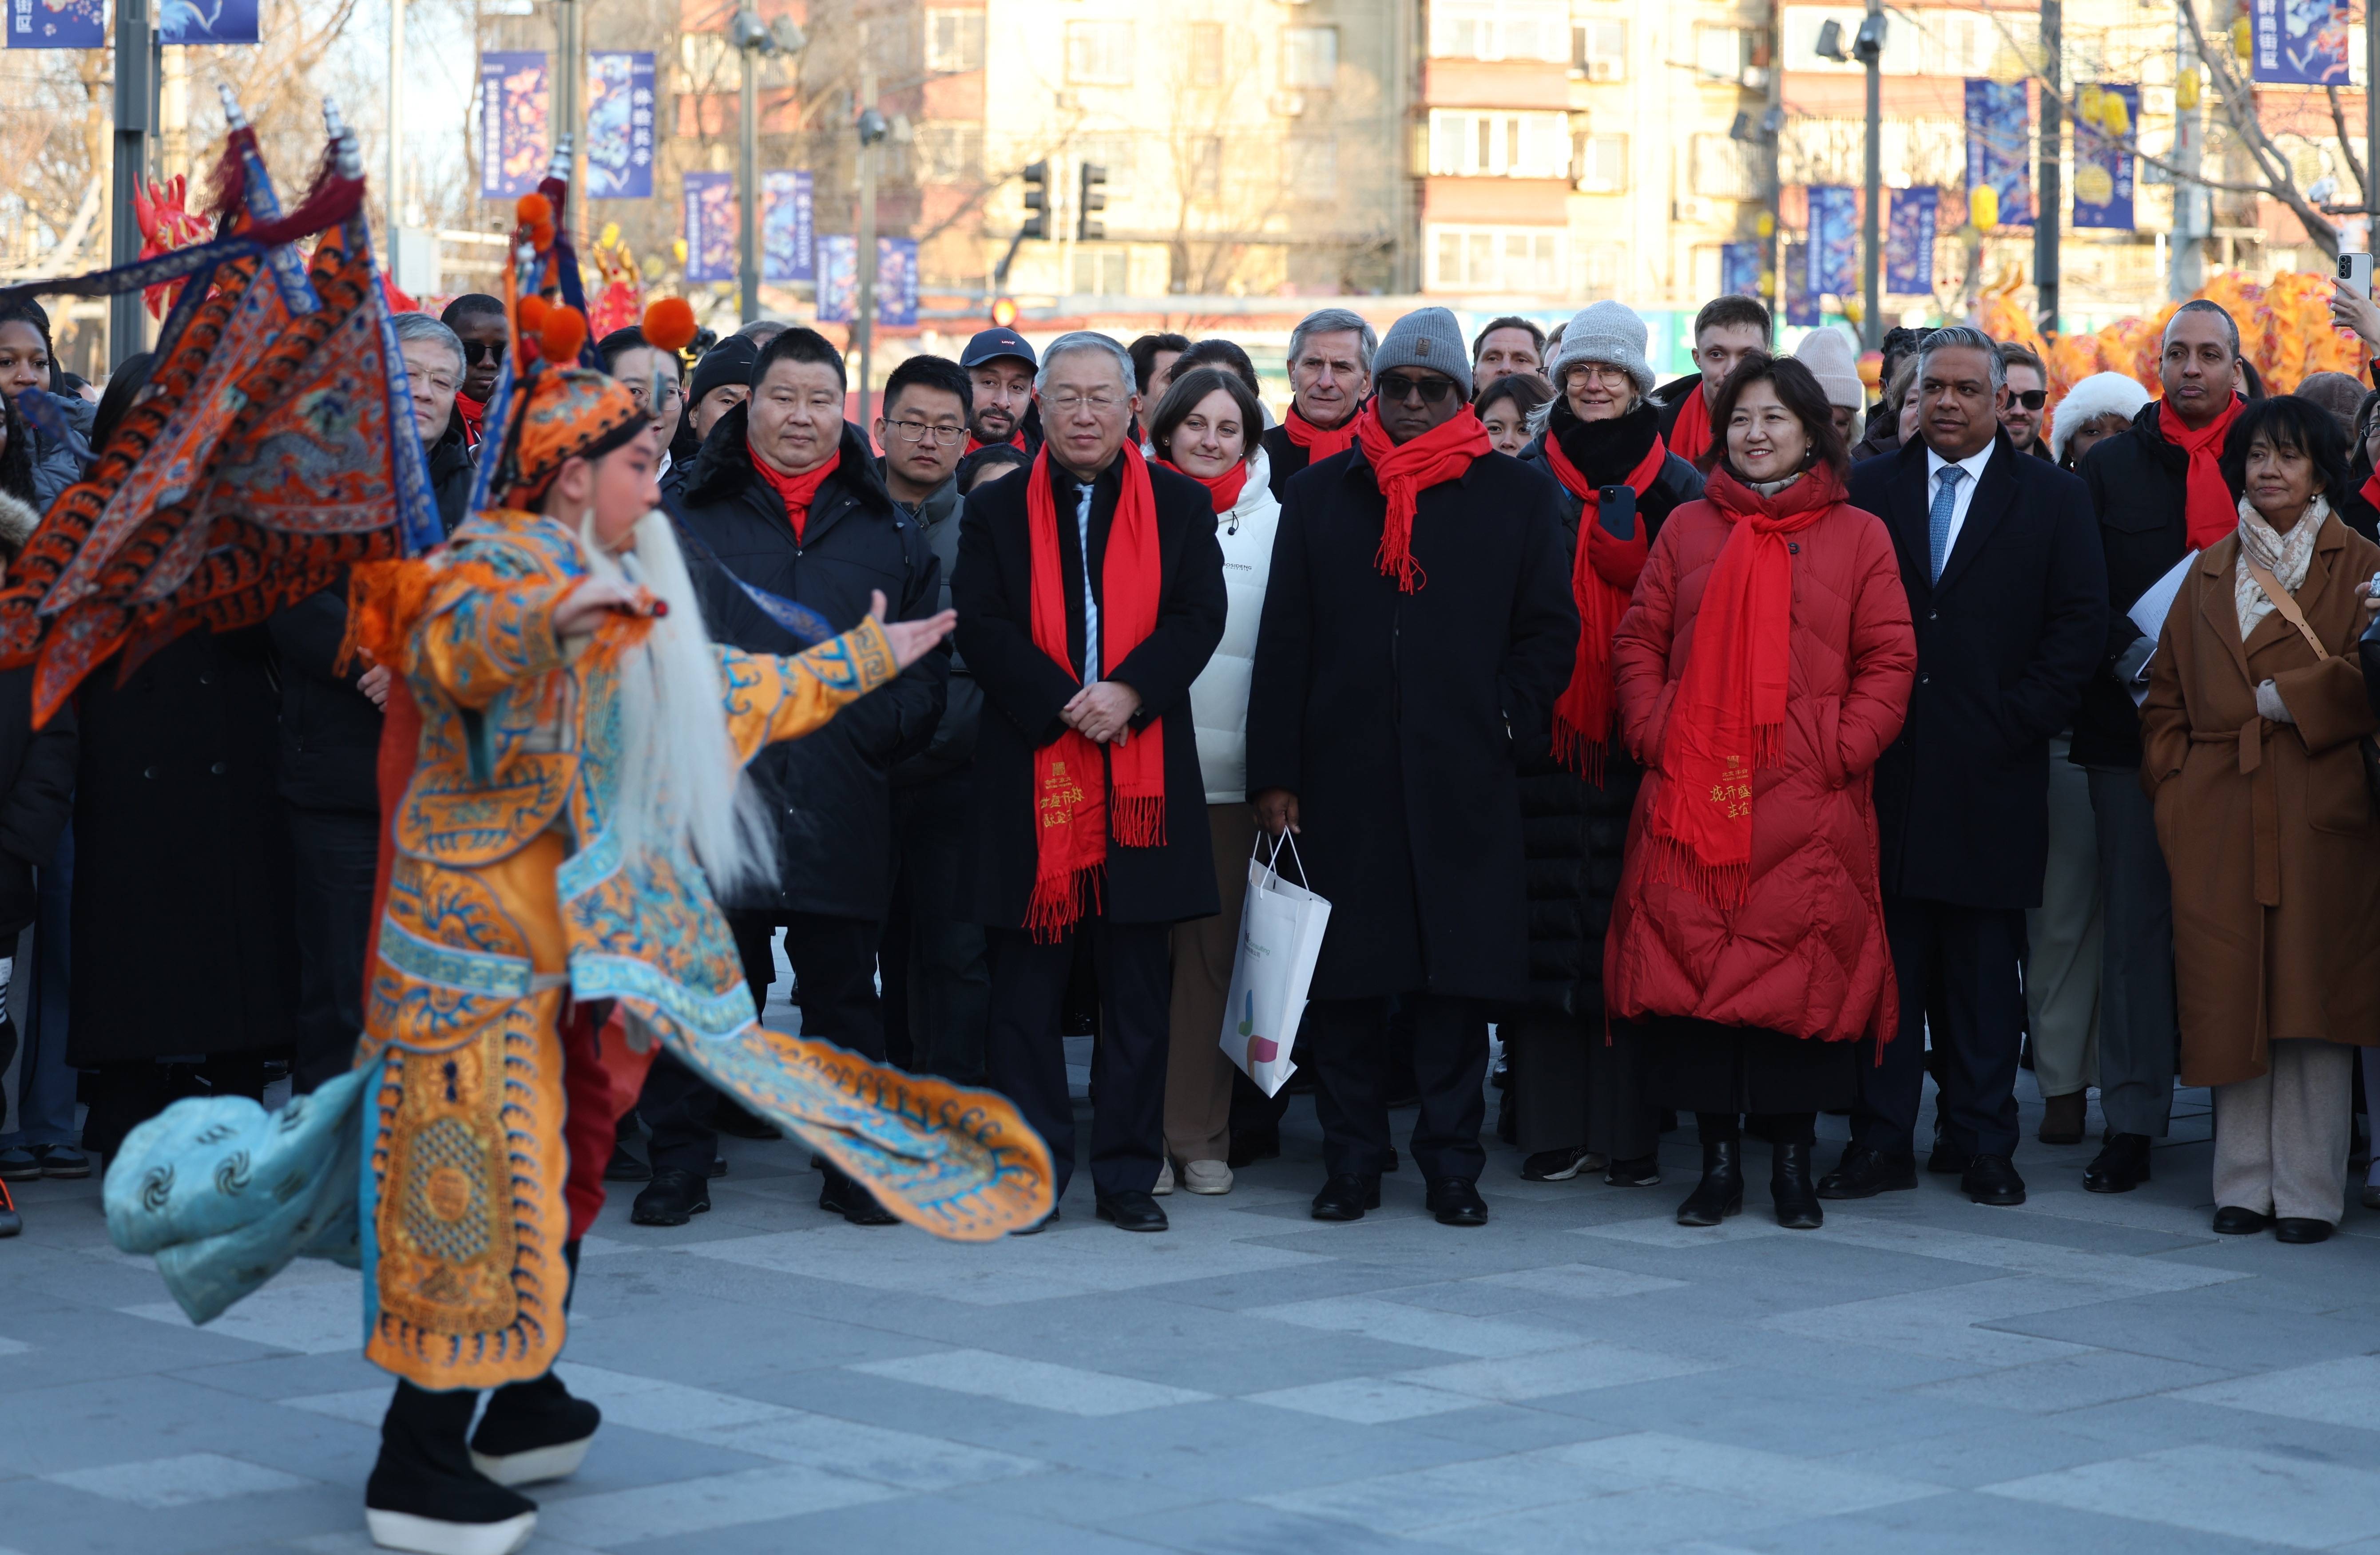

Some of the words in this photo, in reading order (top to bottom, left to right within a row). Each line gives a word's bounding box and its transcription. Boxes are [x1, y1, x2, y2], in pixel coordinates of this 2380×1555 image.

[1710, 784, 1752, 803] 花开盛
[1727, 800, 1752, 825] 丰宜
